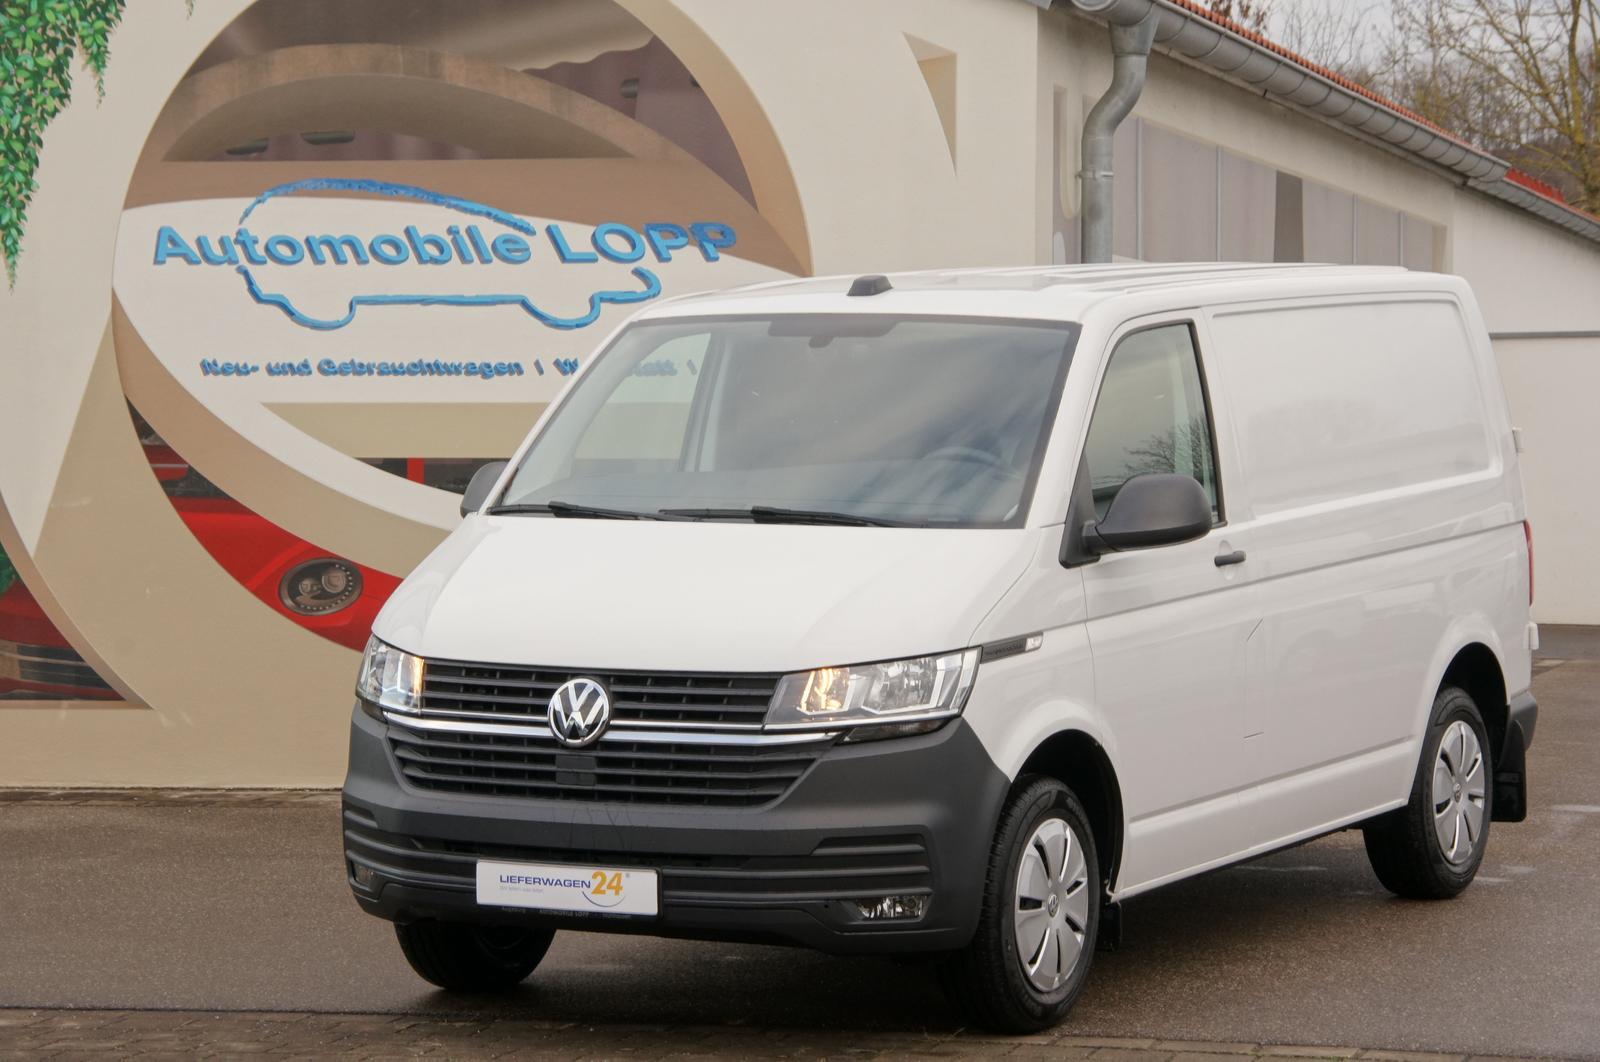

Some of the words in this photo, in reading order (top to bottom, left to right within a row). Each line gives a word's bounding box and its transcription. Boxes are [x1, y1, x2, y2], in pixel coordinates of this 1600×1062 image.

[154, 223, 532, 265] Automobile
[545, 221, 737, 264] LOPP
[265, 358, 313, 376] und
[317, 358, 525, 379] Gebrauchtwagen
